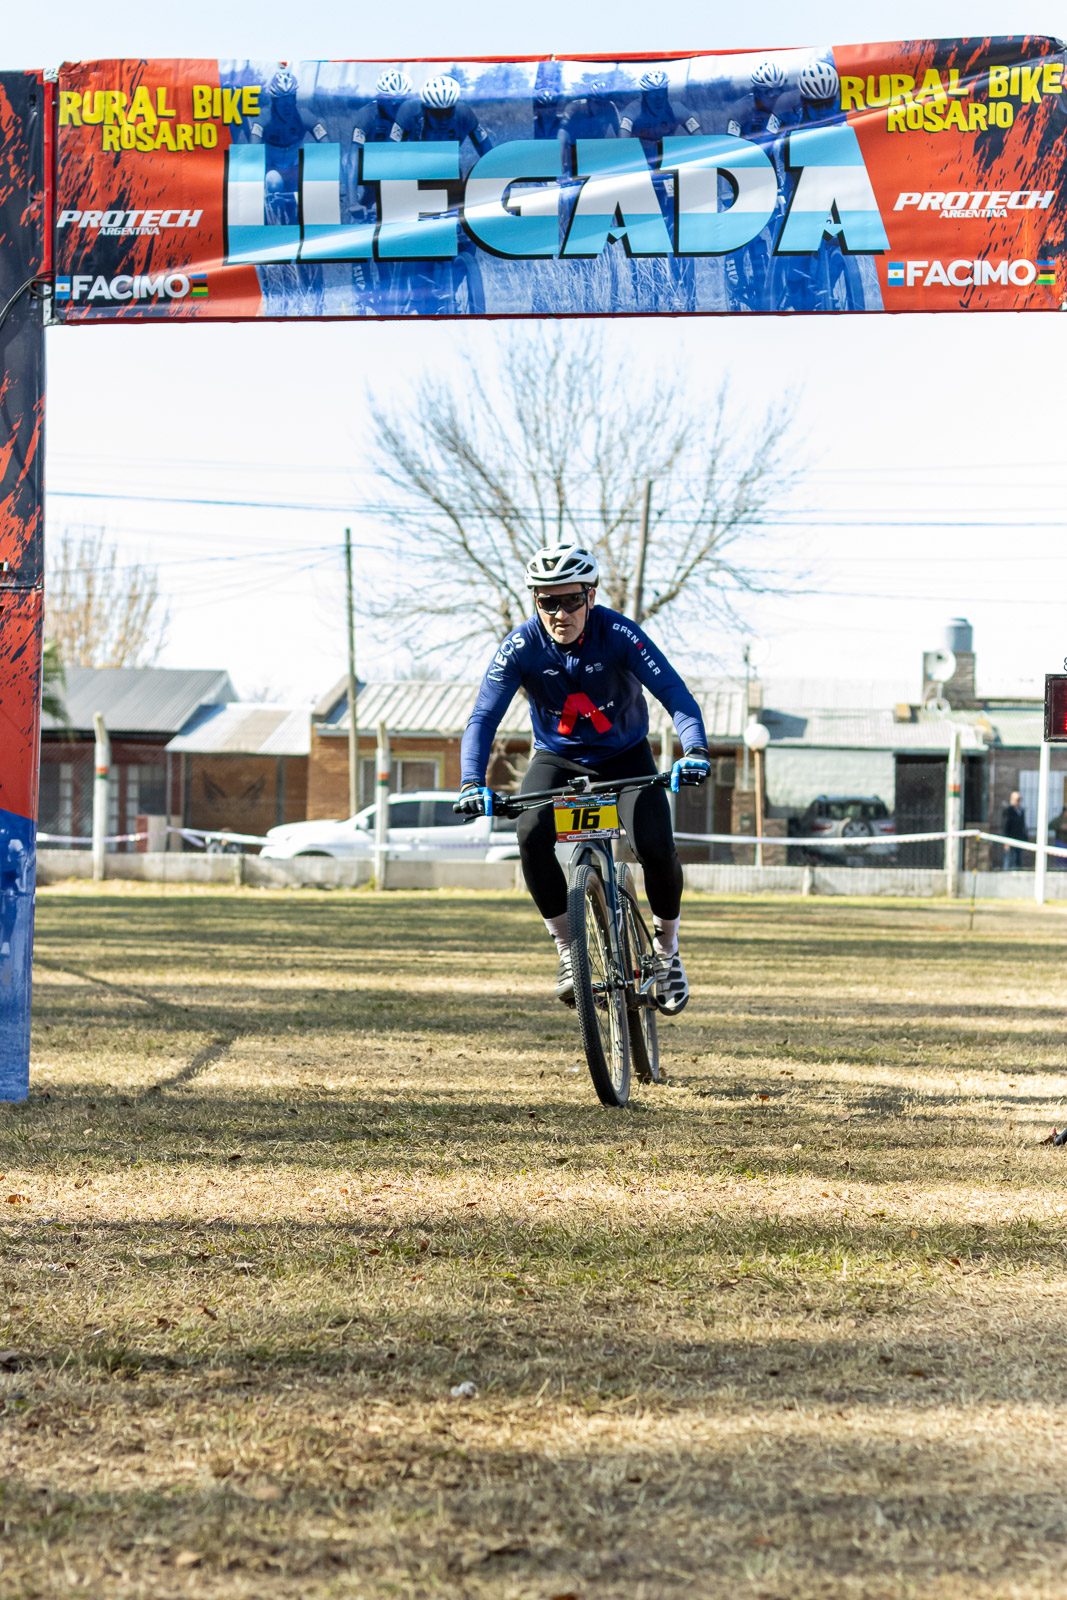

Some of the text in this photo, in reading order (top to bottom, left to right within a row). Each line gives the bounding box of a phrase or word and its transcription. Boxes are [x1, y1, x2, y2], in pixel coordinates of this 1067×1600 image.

[840, 63, 1064, 111] RURAL BIKE
[58, 85, 262, 127] RURAL BIKE
[887, 101, 1014, 132] ROSARIO
[102, 121, 218, 152] ROSARIO
[222, 126, 891, 266] LLEGADA
[893, 190, 1055, 211] PROTECH
[56, 209, 204, 228] PROTECH
[939, 209, 1008, 219] ARGENTINA
[97, 227, 160, 236] ARGENTINA
[72, 273, 190, 300] FACIMO
[906, 258, 1037, 287] FACIMO
[487, 632, 526, 682] INEOS
[612, 622, 661, 676] GRENADIER
[570, 807, 602, 831] 16
